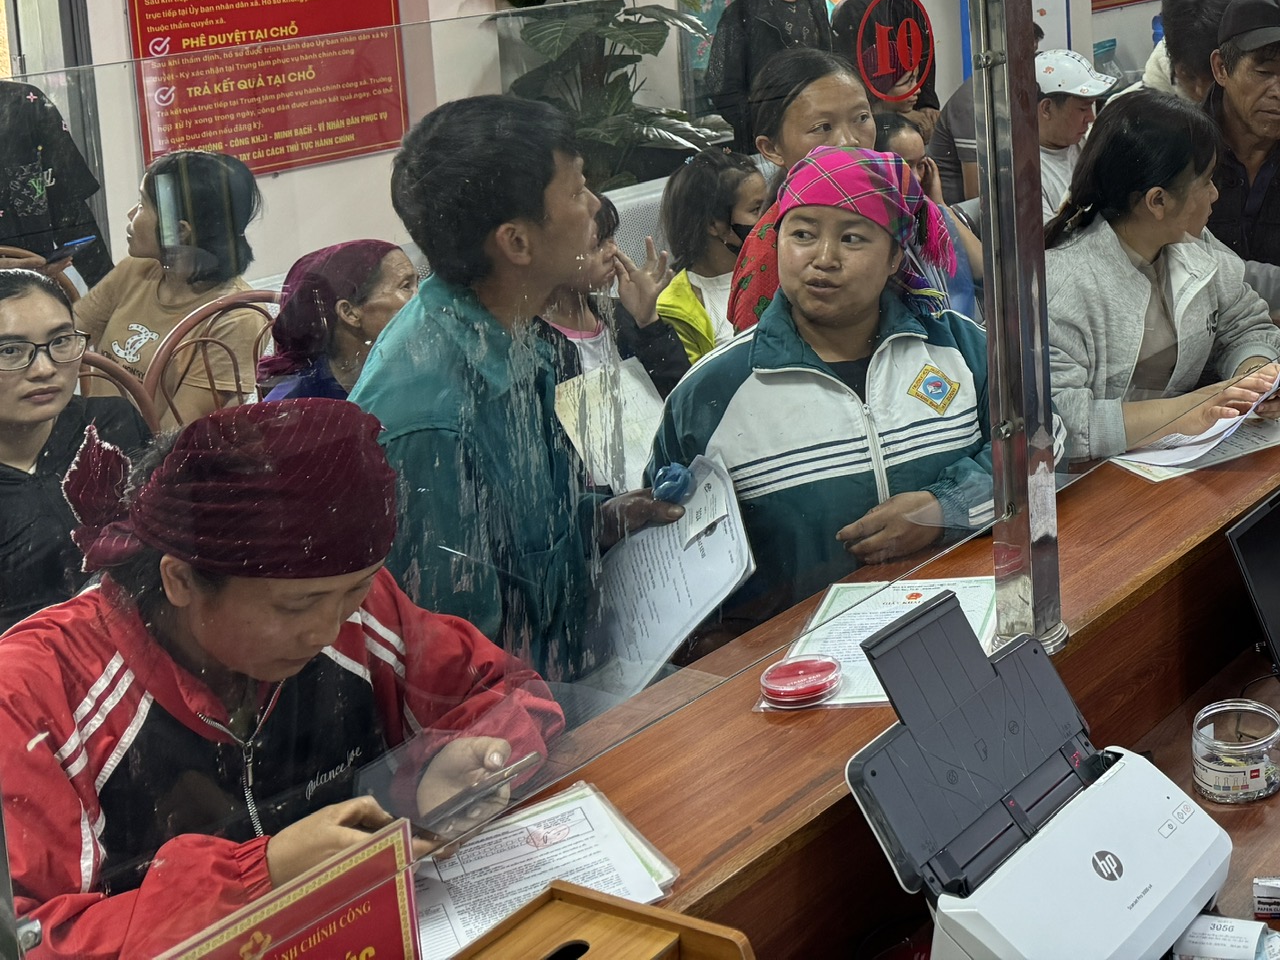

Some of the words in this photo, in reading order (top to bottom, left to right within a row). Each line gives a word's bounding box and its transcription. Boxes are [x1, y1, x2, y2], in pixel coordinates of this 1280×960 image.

[182, 33, 207, 49] PHÊ
[210, 29, 247, 45] DUYỆT
[248, 28, 268, 42] TẠI
[270, 20, 298, 36] CHỖ
[186, 81, 212, 97] TRẢ
[213, 78, 235, 93] KẾT
[237, 74, 265, 90] QUẢ
[266, 74, 286, 87] TẠI
[288, 64, 316, 82] CHỖ
[230, 139, 251, 147] CÔNG
[274, 129, 293, 140] MINH
[360, 113, 378, 123] PHỤC
[379, 112, 388, 121] VỤ
[252, 149, 264, 159] CẢI
[266, 145, 285, 157] CÁCH
[286, 140, 299, 153] THỦ
[300, 139, 314, 151] TỤC
[314, 136, 333, 148] HÀNH
[334, 133, 355, 144] CHÍNH
[1092, 851, 1122, 881] hp
[300, 921, 337, 953] CHÍNH
[339, 900, 371, 928] CÔNG
